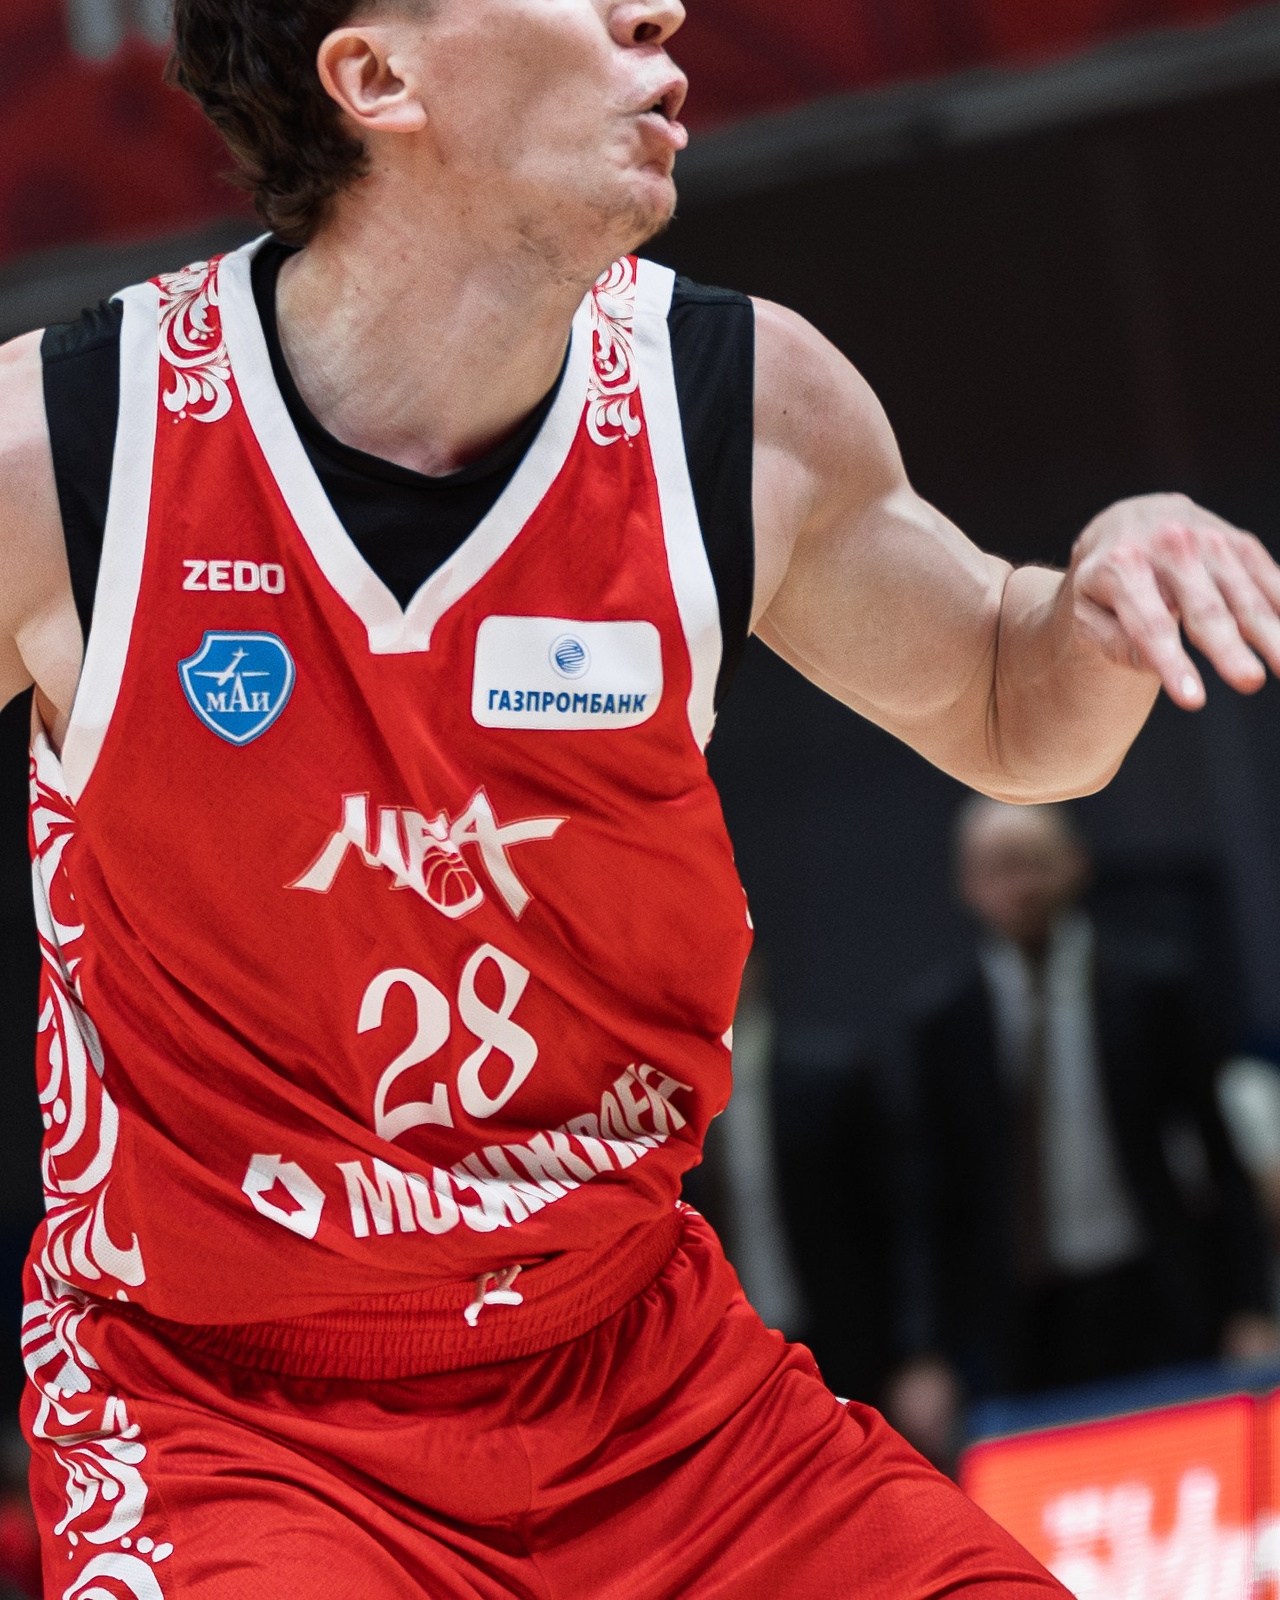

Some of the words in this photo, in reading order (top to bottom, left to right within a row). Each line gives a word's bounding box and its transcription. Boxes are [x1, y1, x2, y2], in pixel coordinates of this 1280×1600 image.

[182, 558, 286, 595] ZEDO
[206, 671, 271, 714] МАИ
[487, 688, 647, 715] ГАЗПРОМБАНК
[357, 942, 539, 1142] 28
